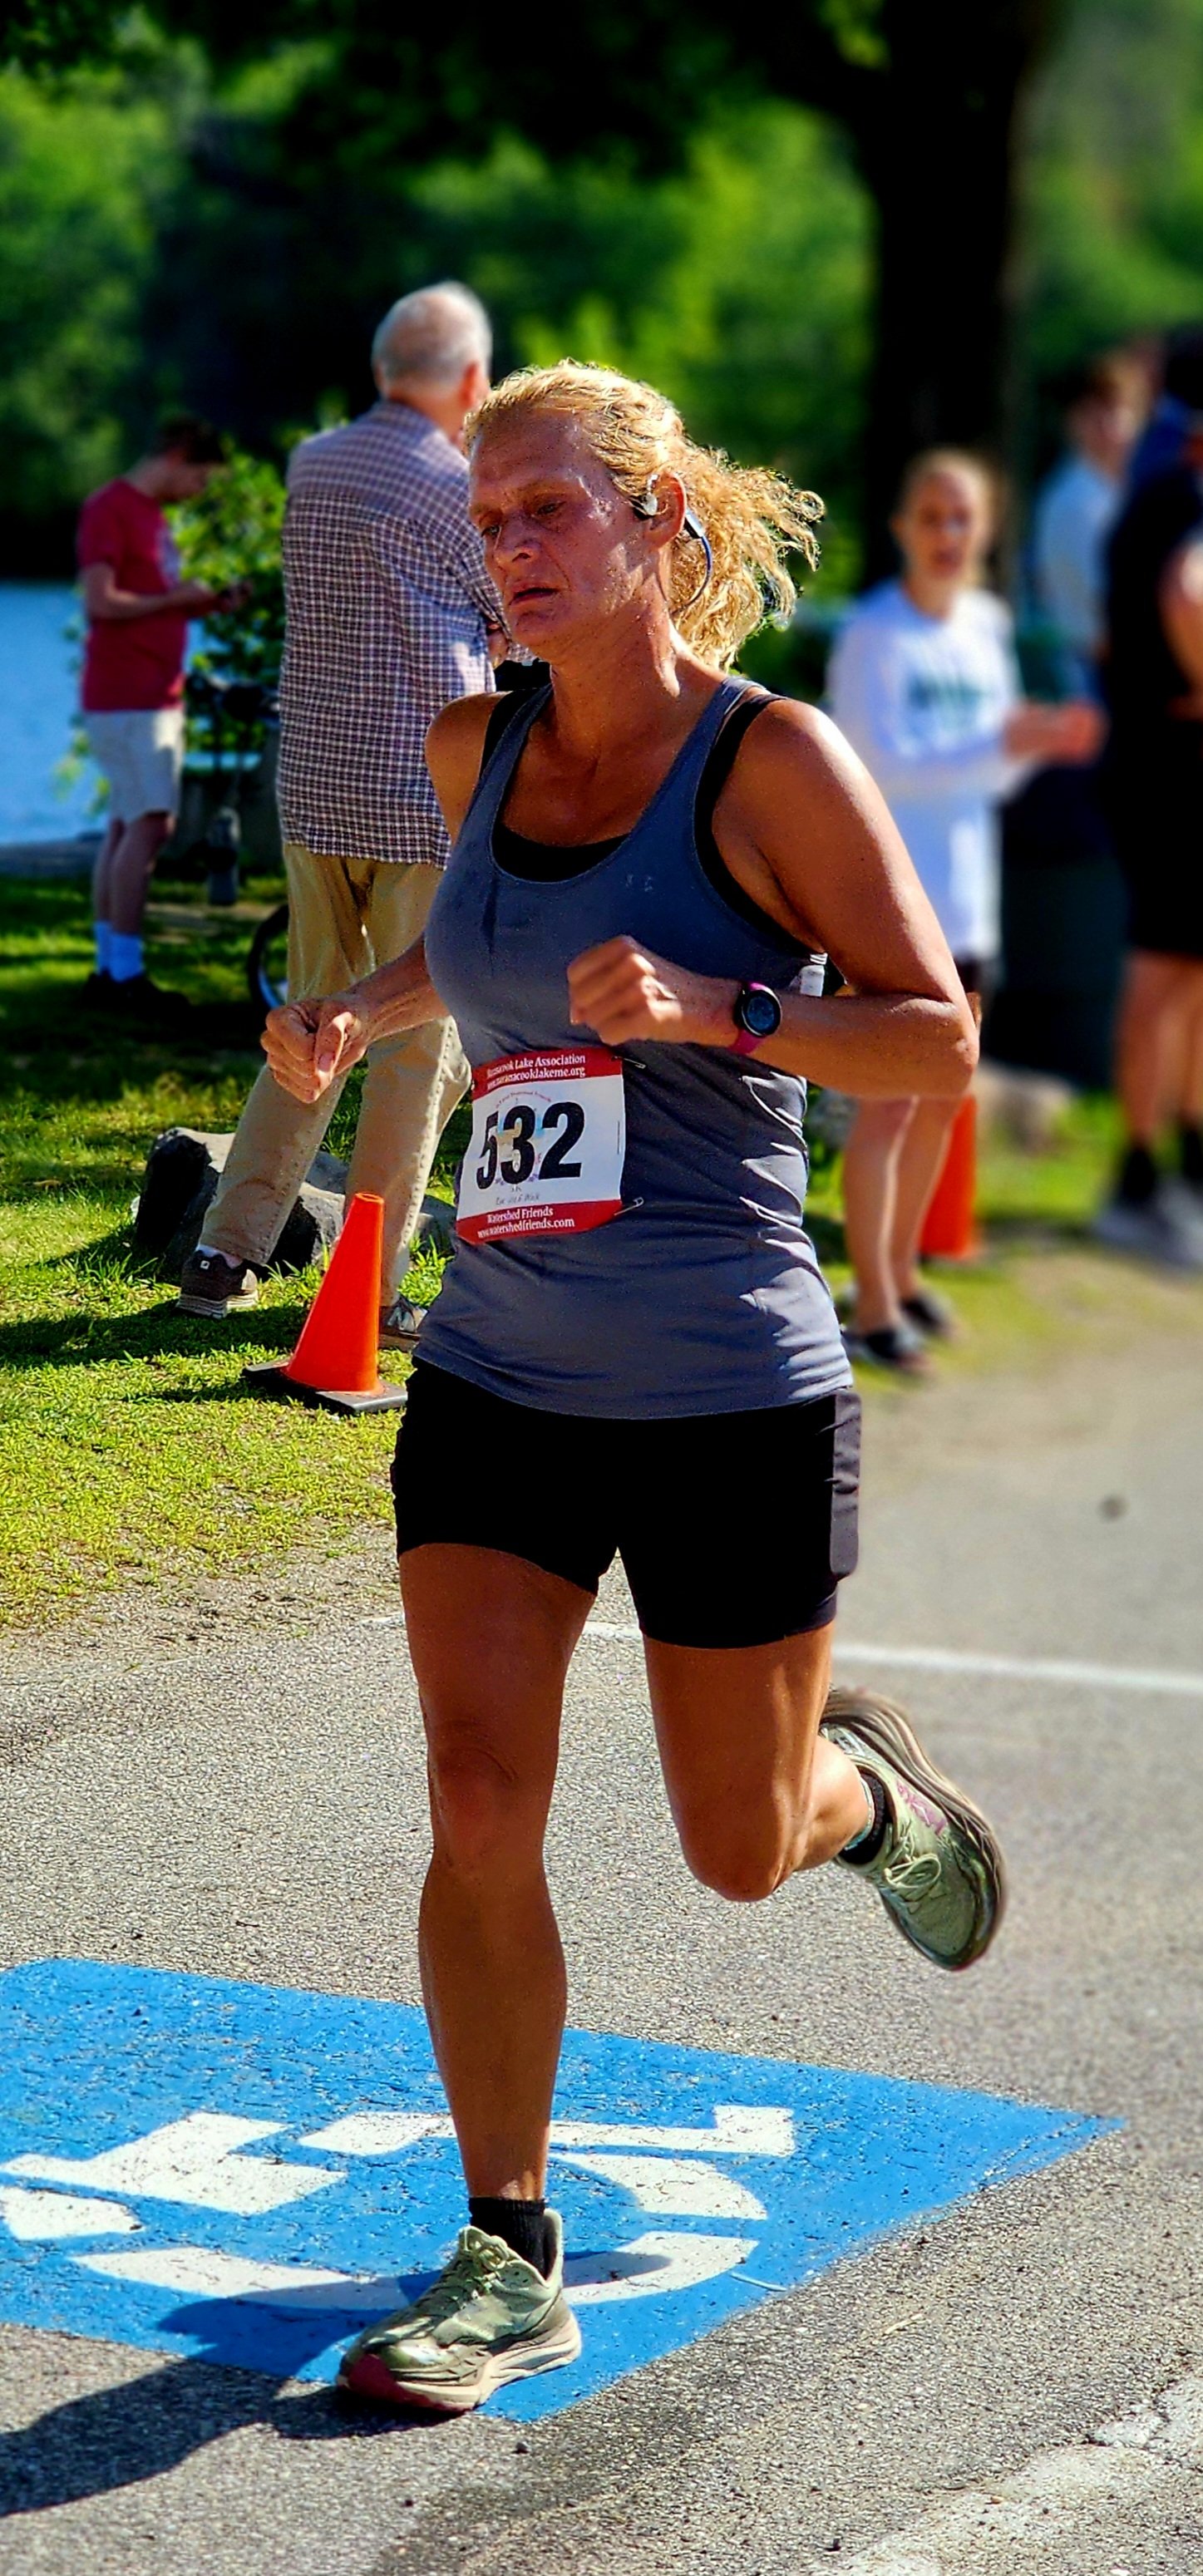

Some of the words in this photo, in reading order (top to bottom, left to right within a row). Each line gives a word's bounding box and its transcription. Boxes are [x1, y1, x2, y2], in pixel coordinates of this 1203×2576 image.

[515, 1057, 534, 1070] Lake
[535, 1053, 586, 1067] Association
[476, 1101, 585, 1189] 532
[521, 1205, 554, 1219] Friends
